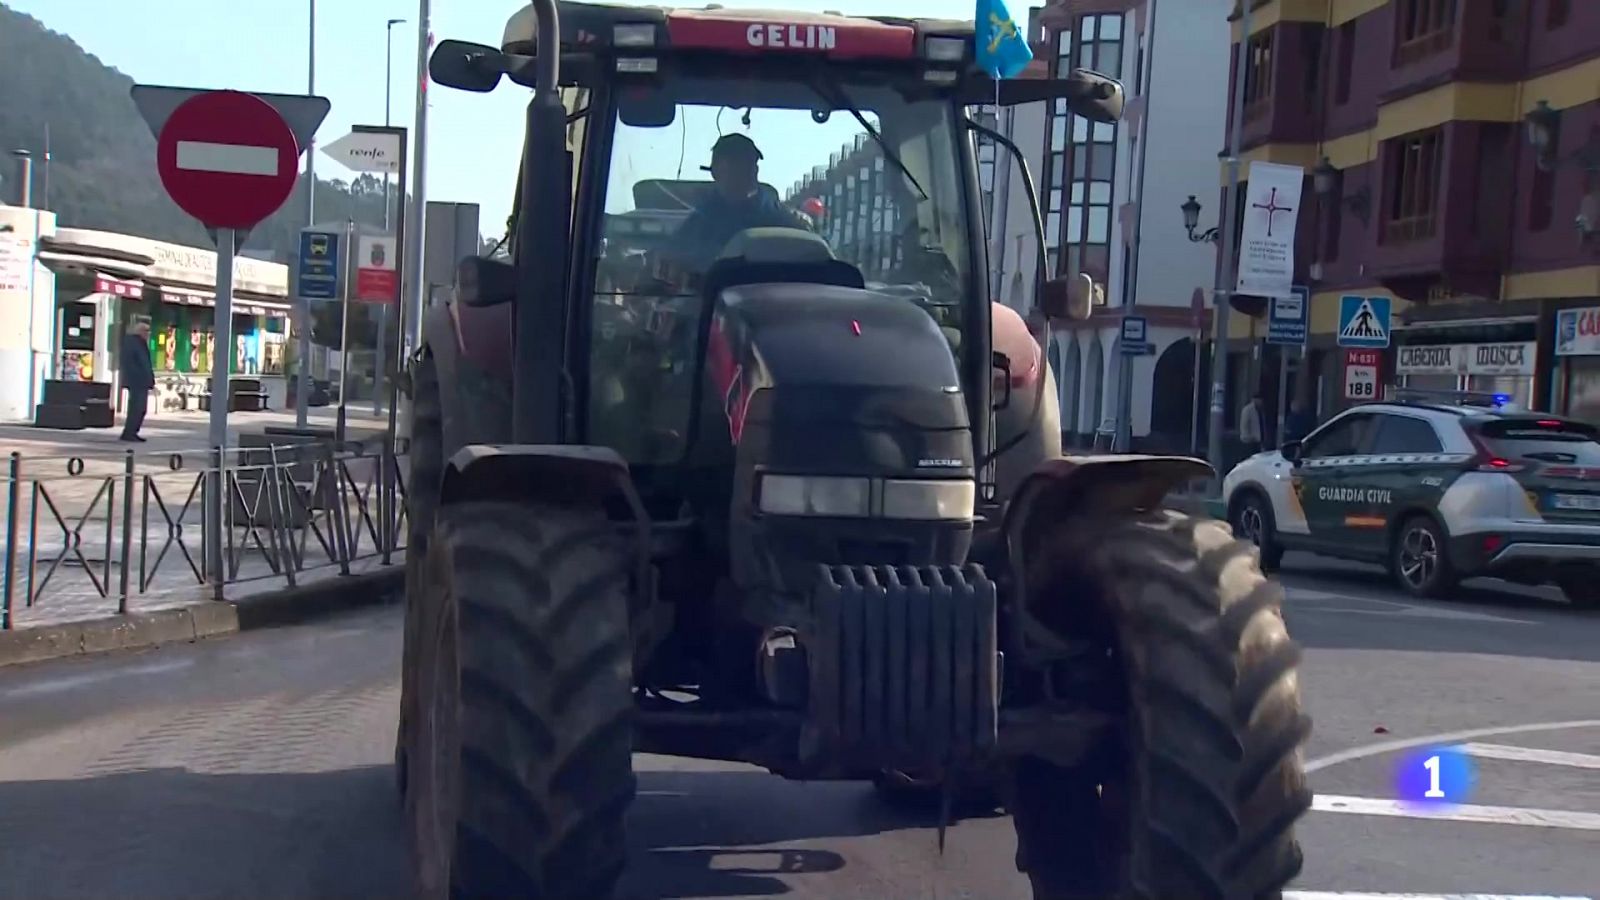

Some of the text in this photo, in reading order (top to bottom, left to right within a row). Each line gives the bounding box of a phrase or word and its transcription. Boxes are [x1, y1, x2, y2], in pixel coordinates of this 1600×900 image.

[746, 23, 836, 49] GELIN
[349, 147, 385, 159] renfe
[1348, 381, 1373, 397] 188
[1318, 486, 1392, 504] GUARDIA CIVIL
